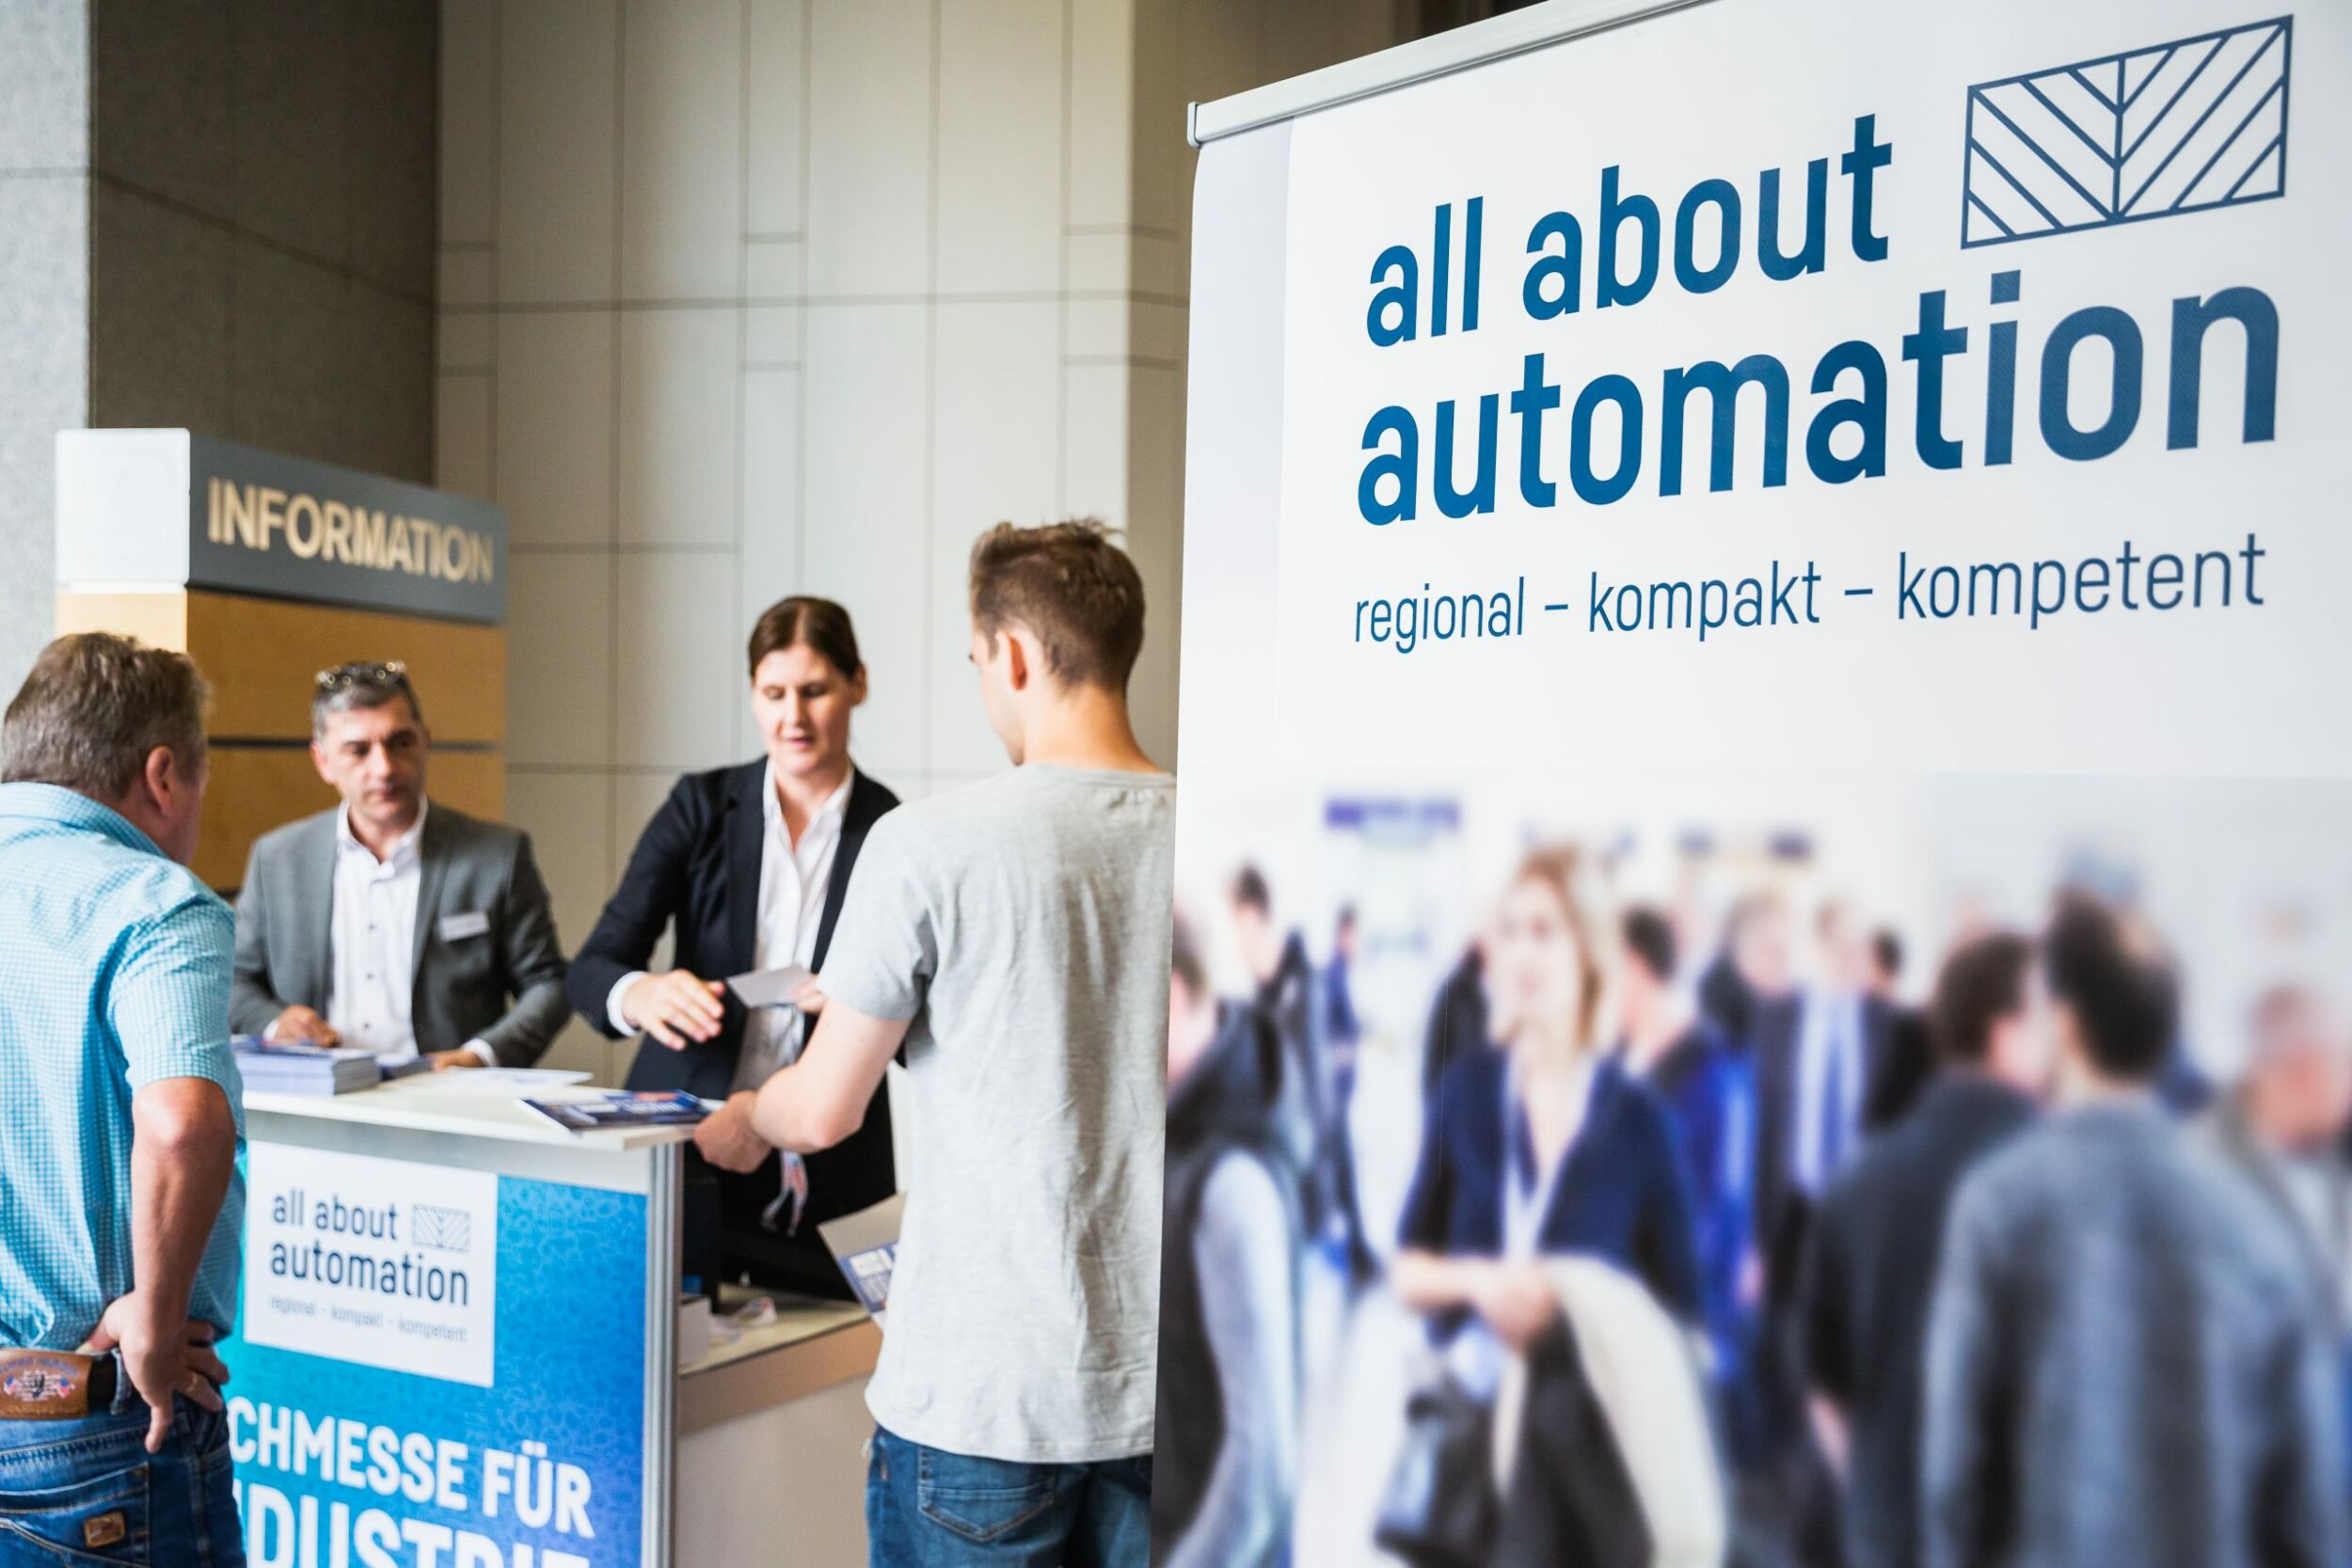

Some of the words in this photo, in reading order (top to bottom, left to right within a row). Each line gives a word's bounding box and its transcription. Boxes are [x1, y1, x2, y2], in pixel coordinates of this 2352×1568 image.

[1366, 196, 1484, 348] all
[1522, 113, 1893, 321] about
[1357, 269, 2280, 527] automation
[207, 475, 494, 585] INFORMATION
[1355, 576, 1525, 656] regional
[1588, 560, 1821, 642] kompakt
[1898, 532, 2266, 631] kompetent
[273, 1189, 305, 1226] all
[314, 1195, 398, 1241] about
[270, 1240, 469, 1307] automation
[482, 1439, 596, 1540] FÜR
